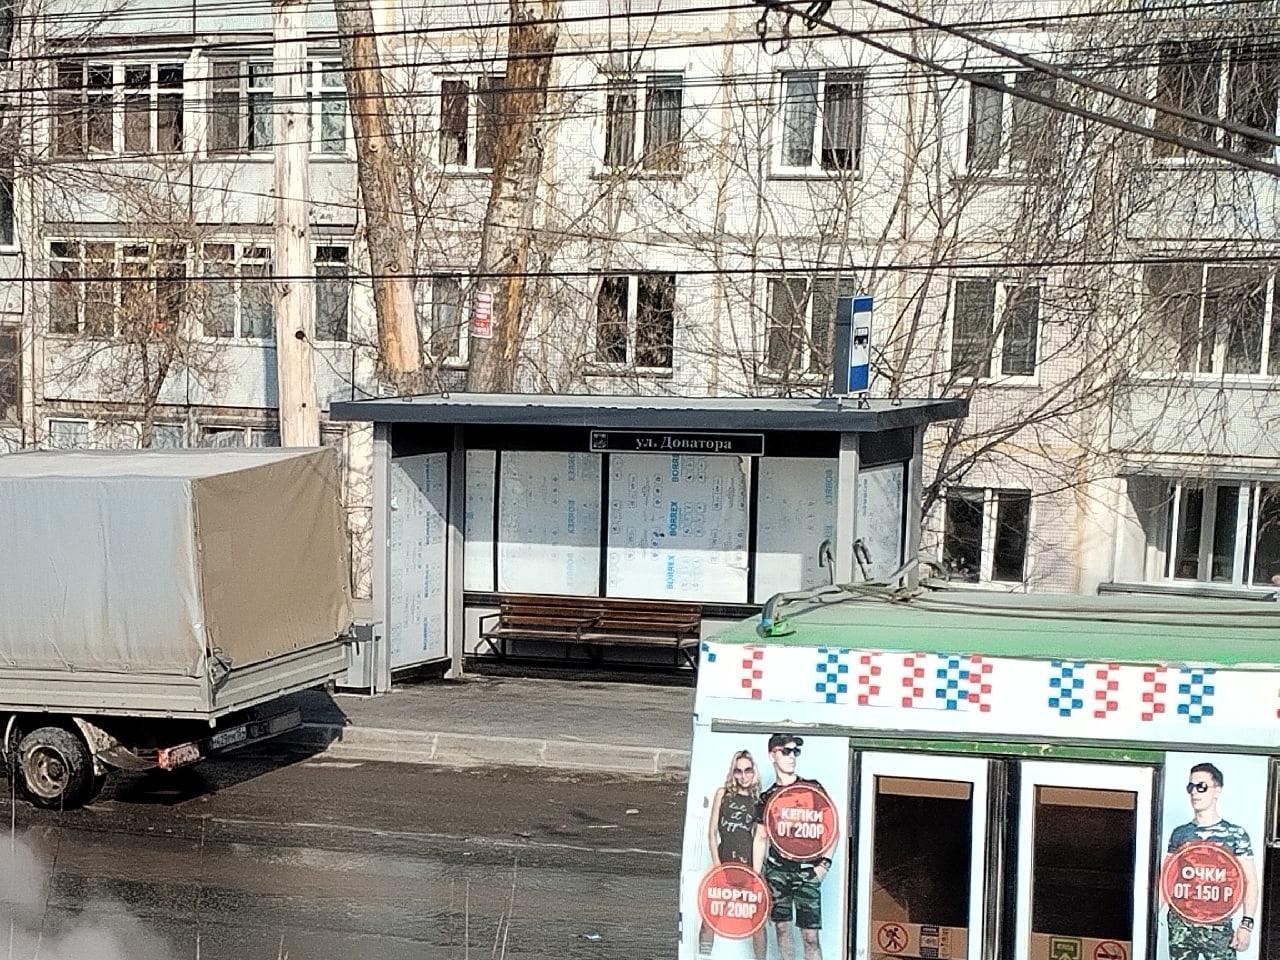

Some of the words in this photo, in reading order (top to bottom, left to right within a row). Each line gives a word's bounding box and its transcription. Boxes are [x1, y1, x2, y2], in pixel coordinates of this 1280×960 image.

[636, 437, 657, 449] ул.
[660, 436, 732, 451] Доватора
[669, 501, 679, 536] BORREX
[781, 807, 823, 823] КЕПКИ
[777, 821, 795, 837] ОТ
[794, 822, 824, 839] 200Р
[1181, 866, 1226, 881] ОЧКИ
[708, 887, 762, 903] ШОРТЫ
[1174, 883, 1191, 899] ОТ
[1195, 885, 1220, 902] 150
[1224, 887, 1233, 902] Р
[710, 901, 725, 917] ОТ
[726, 902, 757, 918] 200Р
